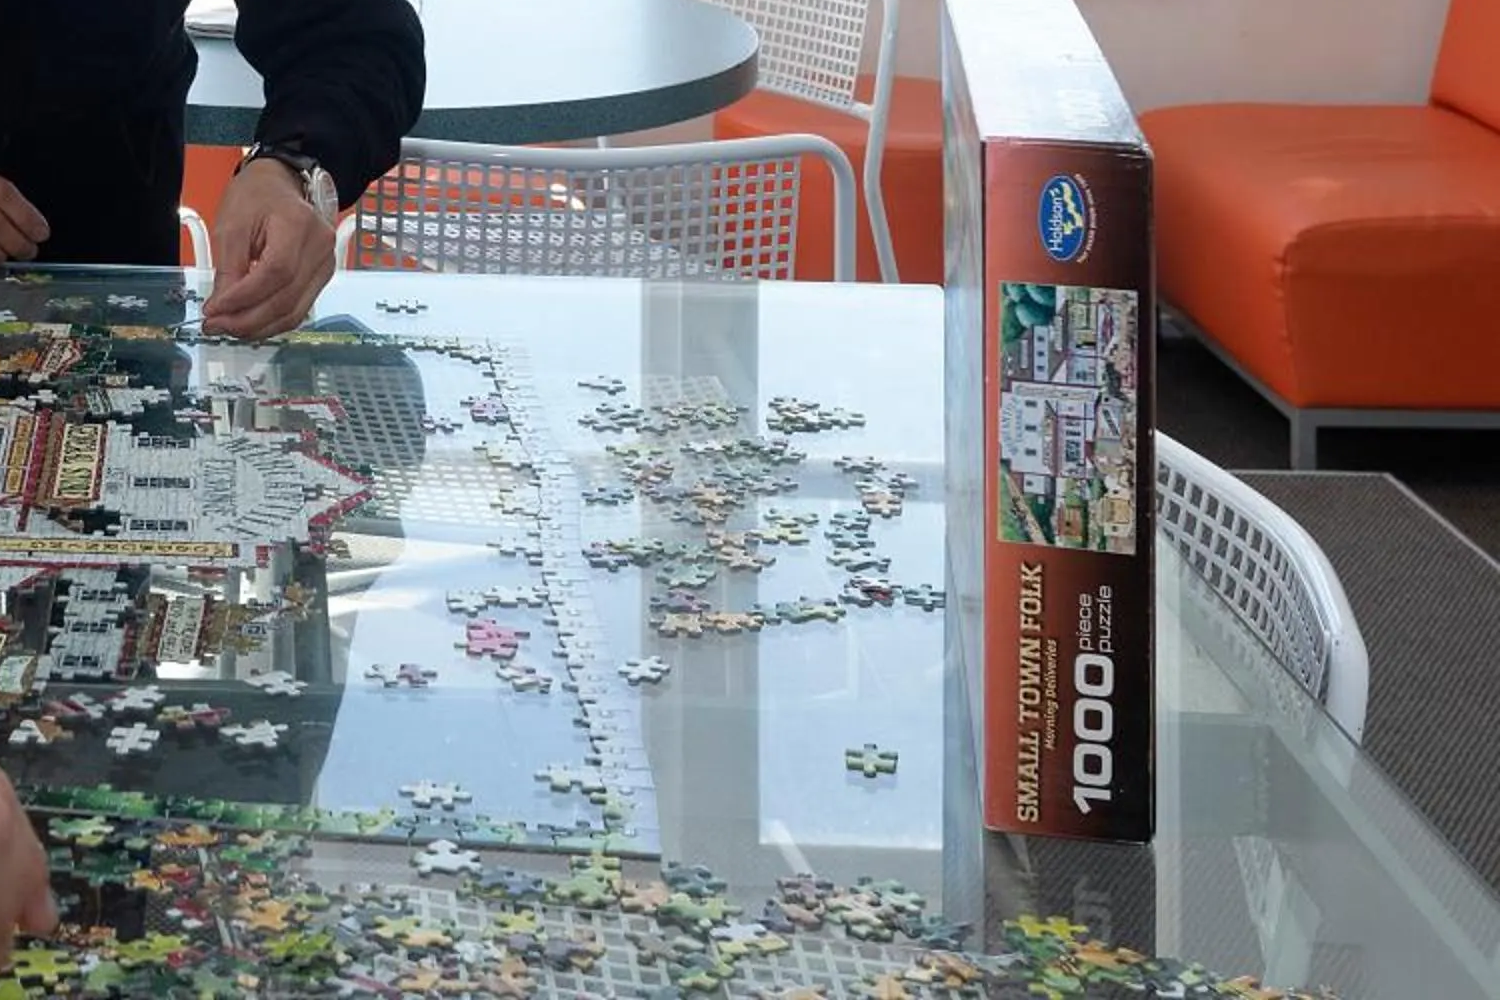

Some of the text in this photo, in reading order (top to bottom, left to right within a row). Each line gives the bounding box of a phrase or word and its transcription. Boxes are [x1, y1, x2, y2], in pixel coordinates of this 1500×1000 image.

[1018, 562, 1043, 822] SMALL TOWN FOLK
[1044, 639, 1059, 751] Morning Deliveries
[1099, 585, 1114, 653] puzzle
[1073, 592, 1114, 815] 1000 piece
